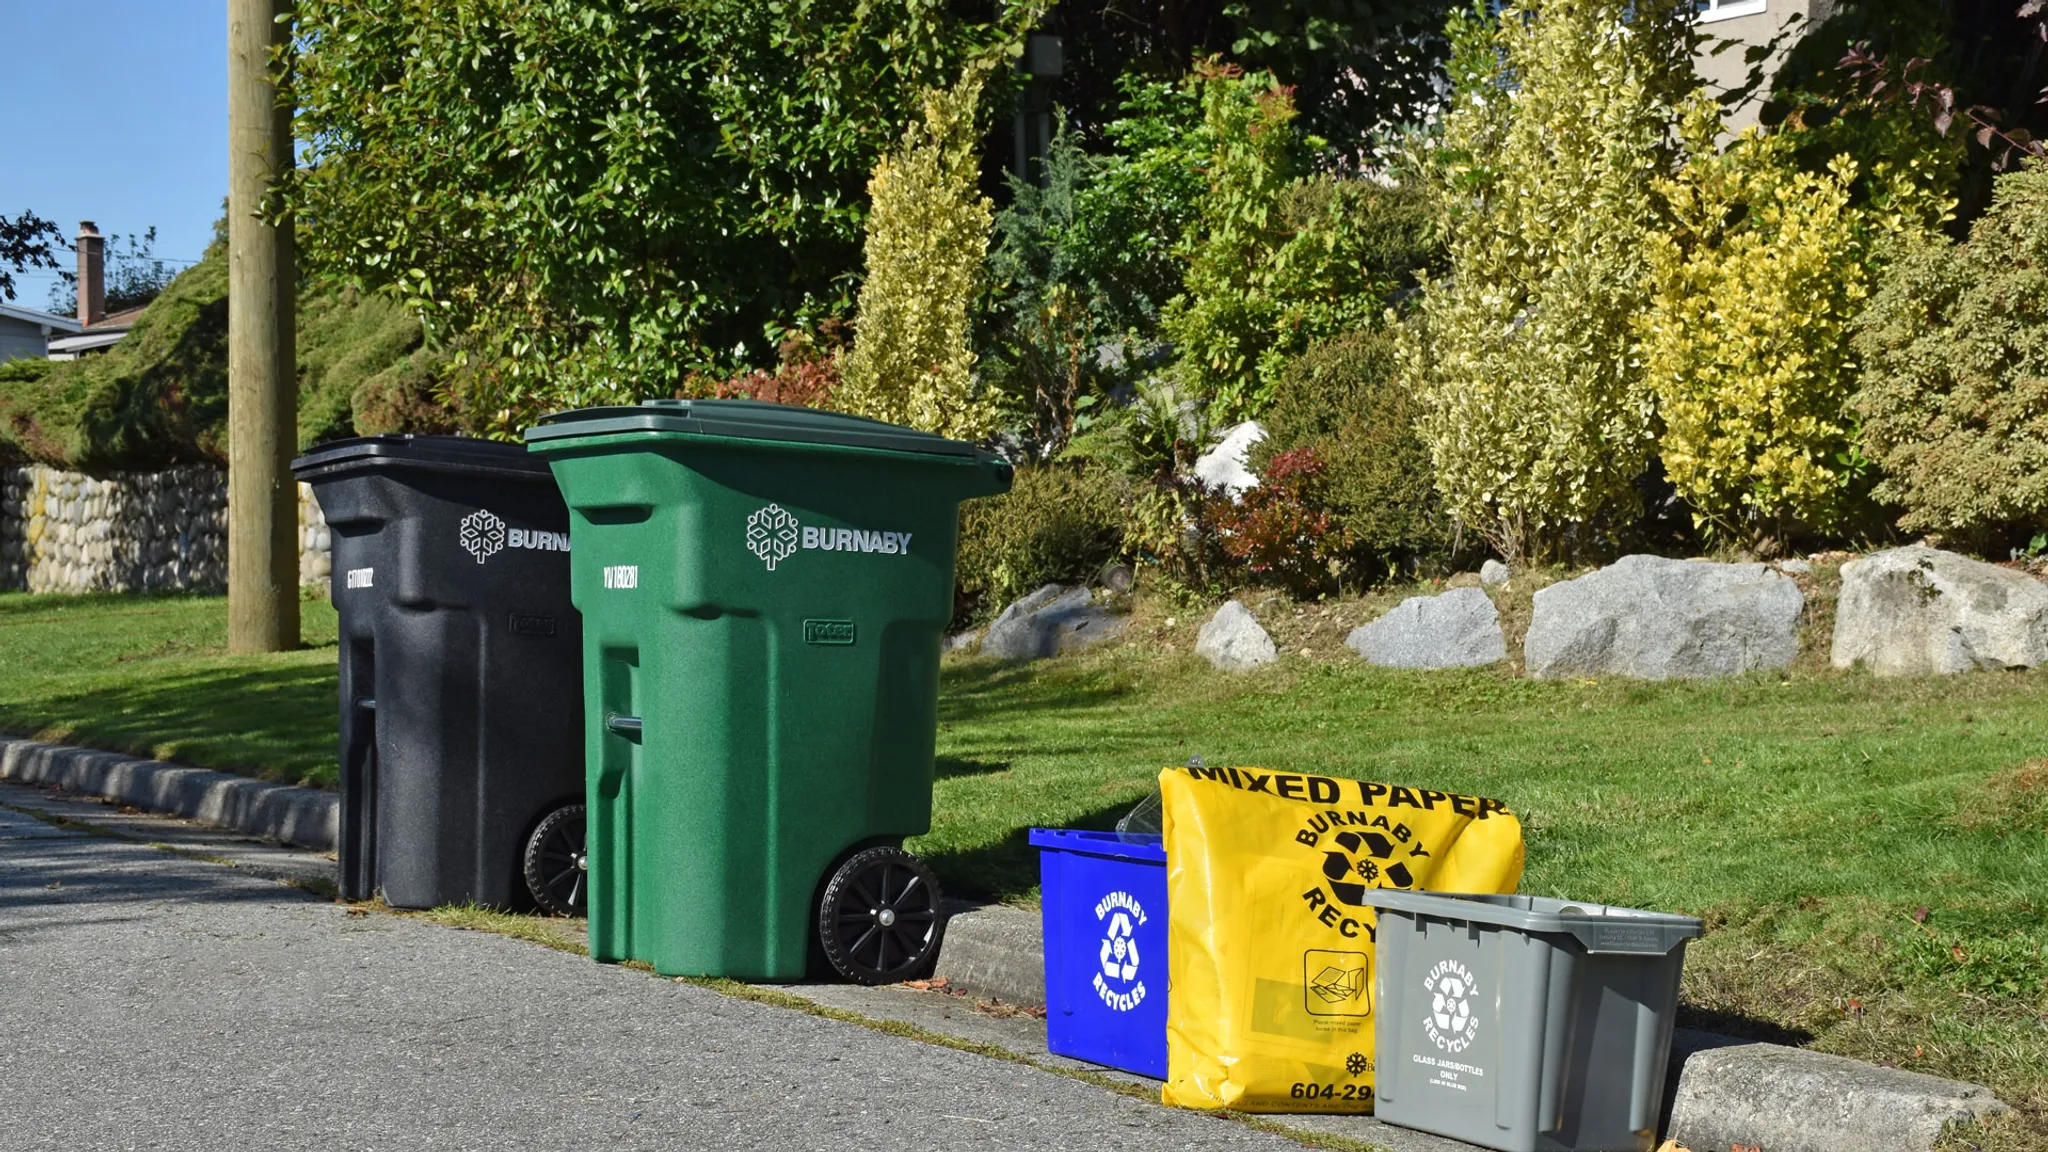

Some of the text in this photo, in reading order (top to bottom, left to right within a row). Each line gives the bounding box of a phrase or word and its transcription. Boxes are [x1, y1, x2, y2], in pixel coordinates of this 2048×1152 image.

[802, 526, 912, 554] BURNABY
[1188, 767, 1511, 820] MIXED PAPER
[1295, 810, 1431, 859] BURNABY
[1095, 891, 1148, 926] BURNABY
[1092, 972, 1146, 1012] RECYCLES
[1423, 959, 1479, 996] BURNABY
[1422, 1016, 1479, 1053] RECYCLES
[1413, 1054, 1484, 1077] GLASS JARS/BOTTLES
[1440, 1070, 1458, 1081] ONLY
[1290, 1082, 1375, 1101] 604-29
